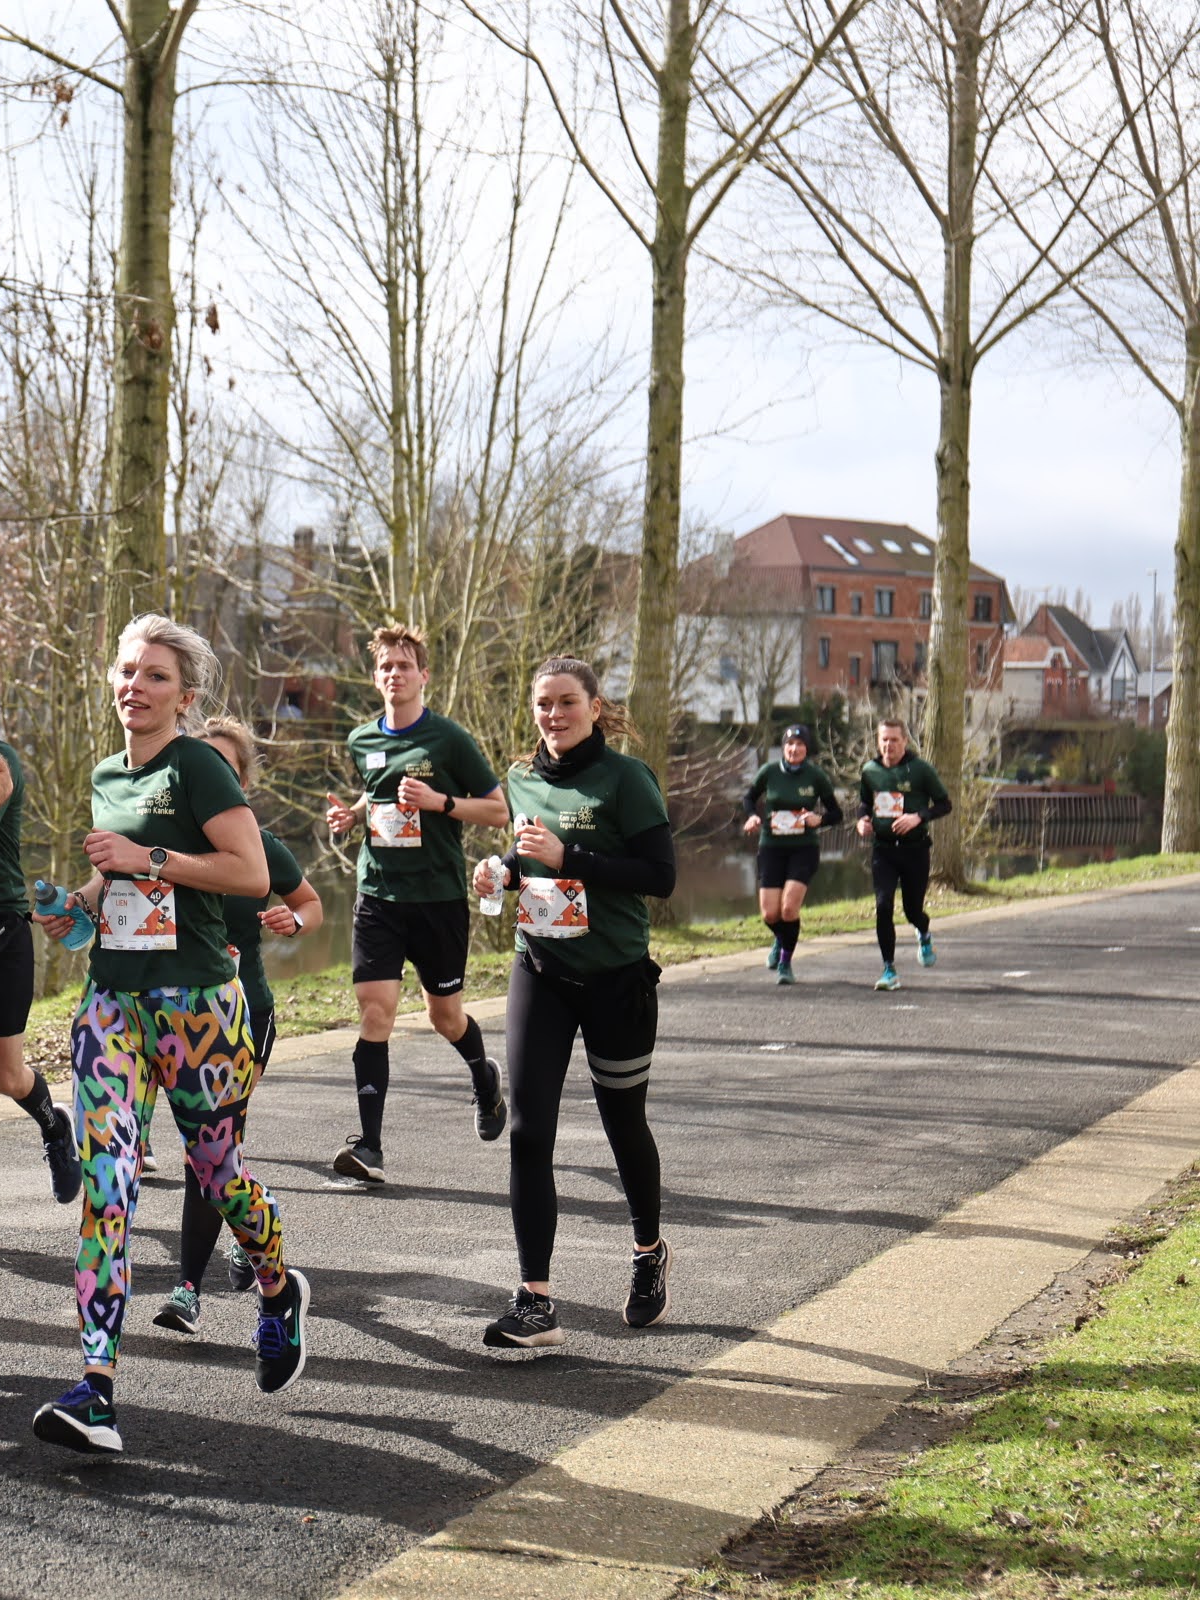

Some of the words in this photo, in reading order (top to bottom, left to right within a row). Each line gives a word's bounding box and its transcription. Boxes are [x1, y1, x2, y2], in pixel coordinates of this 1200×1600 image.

[152, 807, 175, 815] Kanker
[576, 822, 597, 830] Kanker
[150, 892, 161, 900] 40
[566, 889, 576, 897] 40
[538, 907, 549, 917] 80
[117, 915, 127, 926] 81
